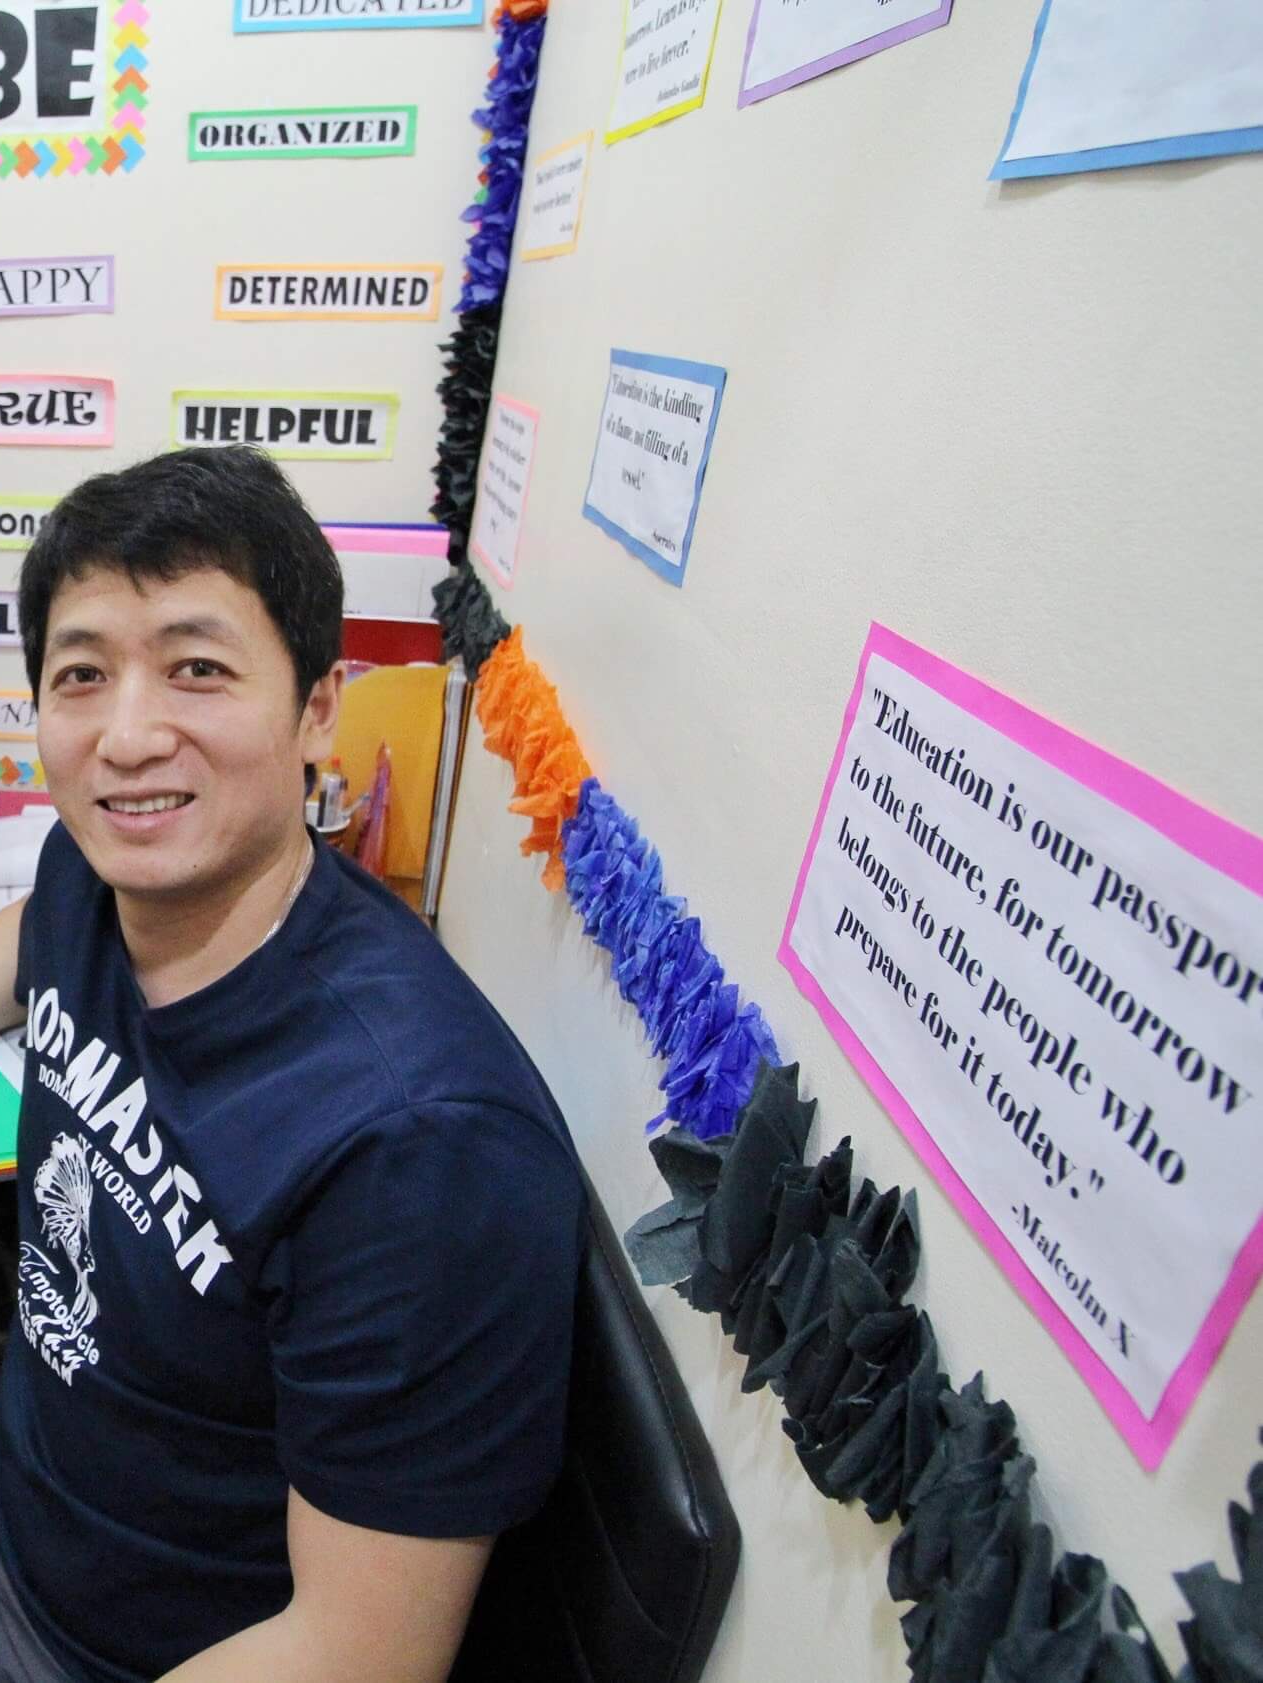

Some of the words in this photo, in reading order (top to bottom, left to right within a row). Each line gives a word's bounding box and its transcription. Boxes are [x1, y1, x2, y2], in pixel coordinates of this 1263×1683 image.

[198, 119, 401, 149] ORGANIZED
[228, 275, 429, 308] DETERMINED
[184, 405, 377, 446] HELPFUL
[644, 428, 672, 462] filling
[663, 388, 704, 423] kindling
[872, 687, 995, 812] "Education
[996, 782, 1030, 834] is
[1031, 818, 1094, 879] our
[848, 754, 871, 793] to
[871, 773, 906, 825] the
[904, 801, 988, 906] future,
[991, 877, 1044, 941] for
[1044, 924, 1254, 1117] tomorrow
[837, 815, 912, 913] belongs
[910, 896, 937, 941] to
[938, 924, 985, 988] the
[979, 974, 1094, 1096] people
[1100, 1083, 1187, 1187] who
[833, 904, 919, 1009] prepare
[919, 991, 960, 1053] for
[958, 1034, 987, 1087] it
[985, 1072, 1106, 1200] today."
[90, 1150, 152, 1235] WORLD
[1011, 1201, 1109, 1330] -Malcolm
[1108, 1318, 1137, 1360] X
